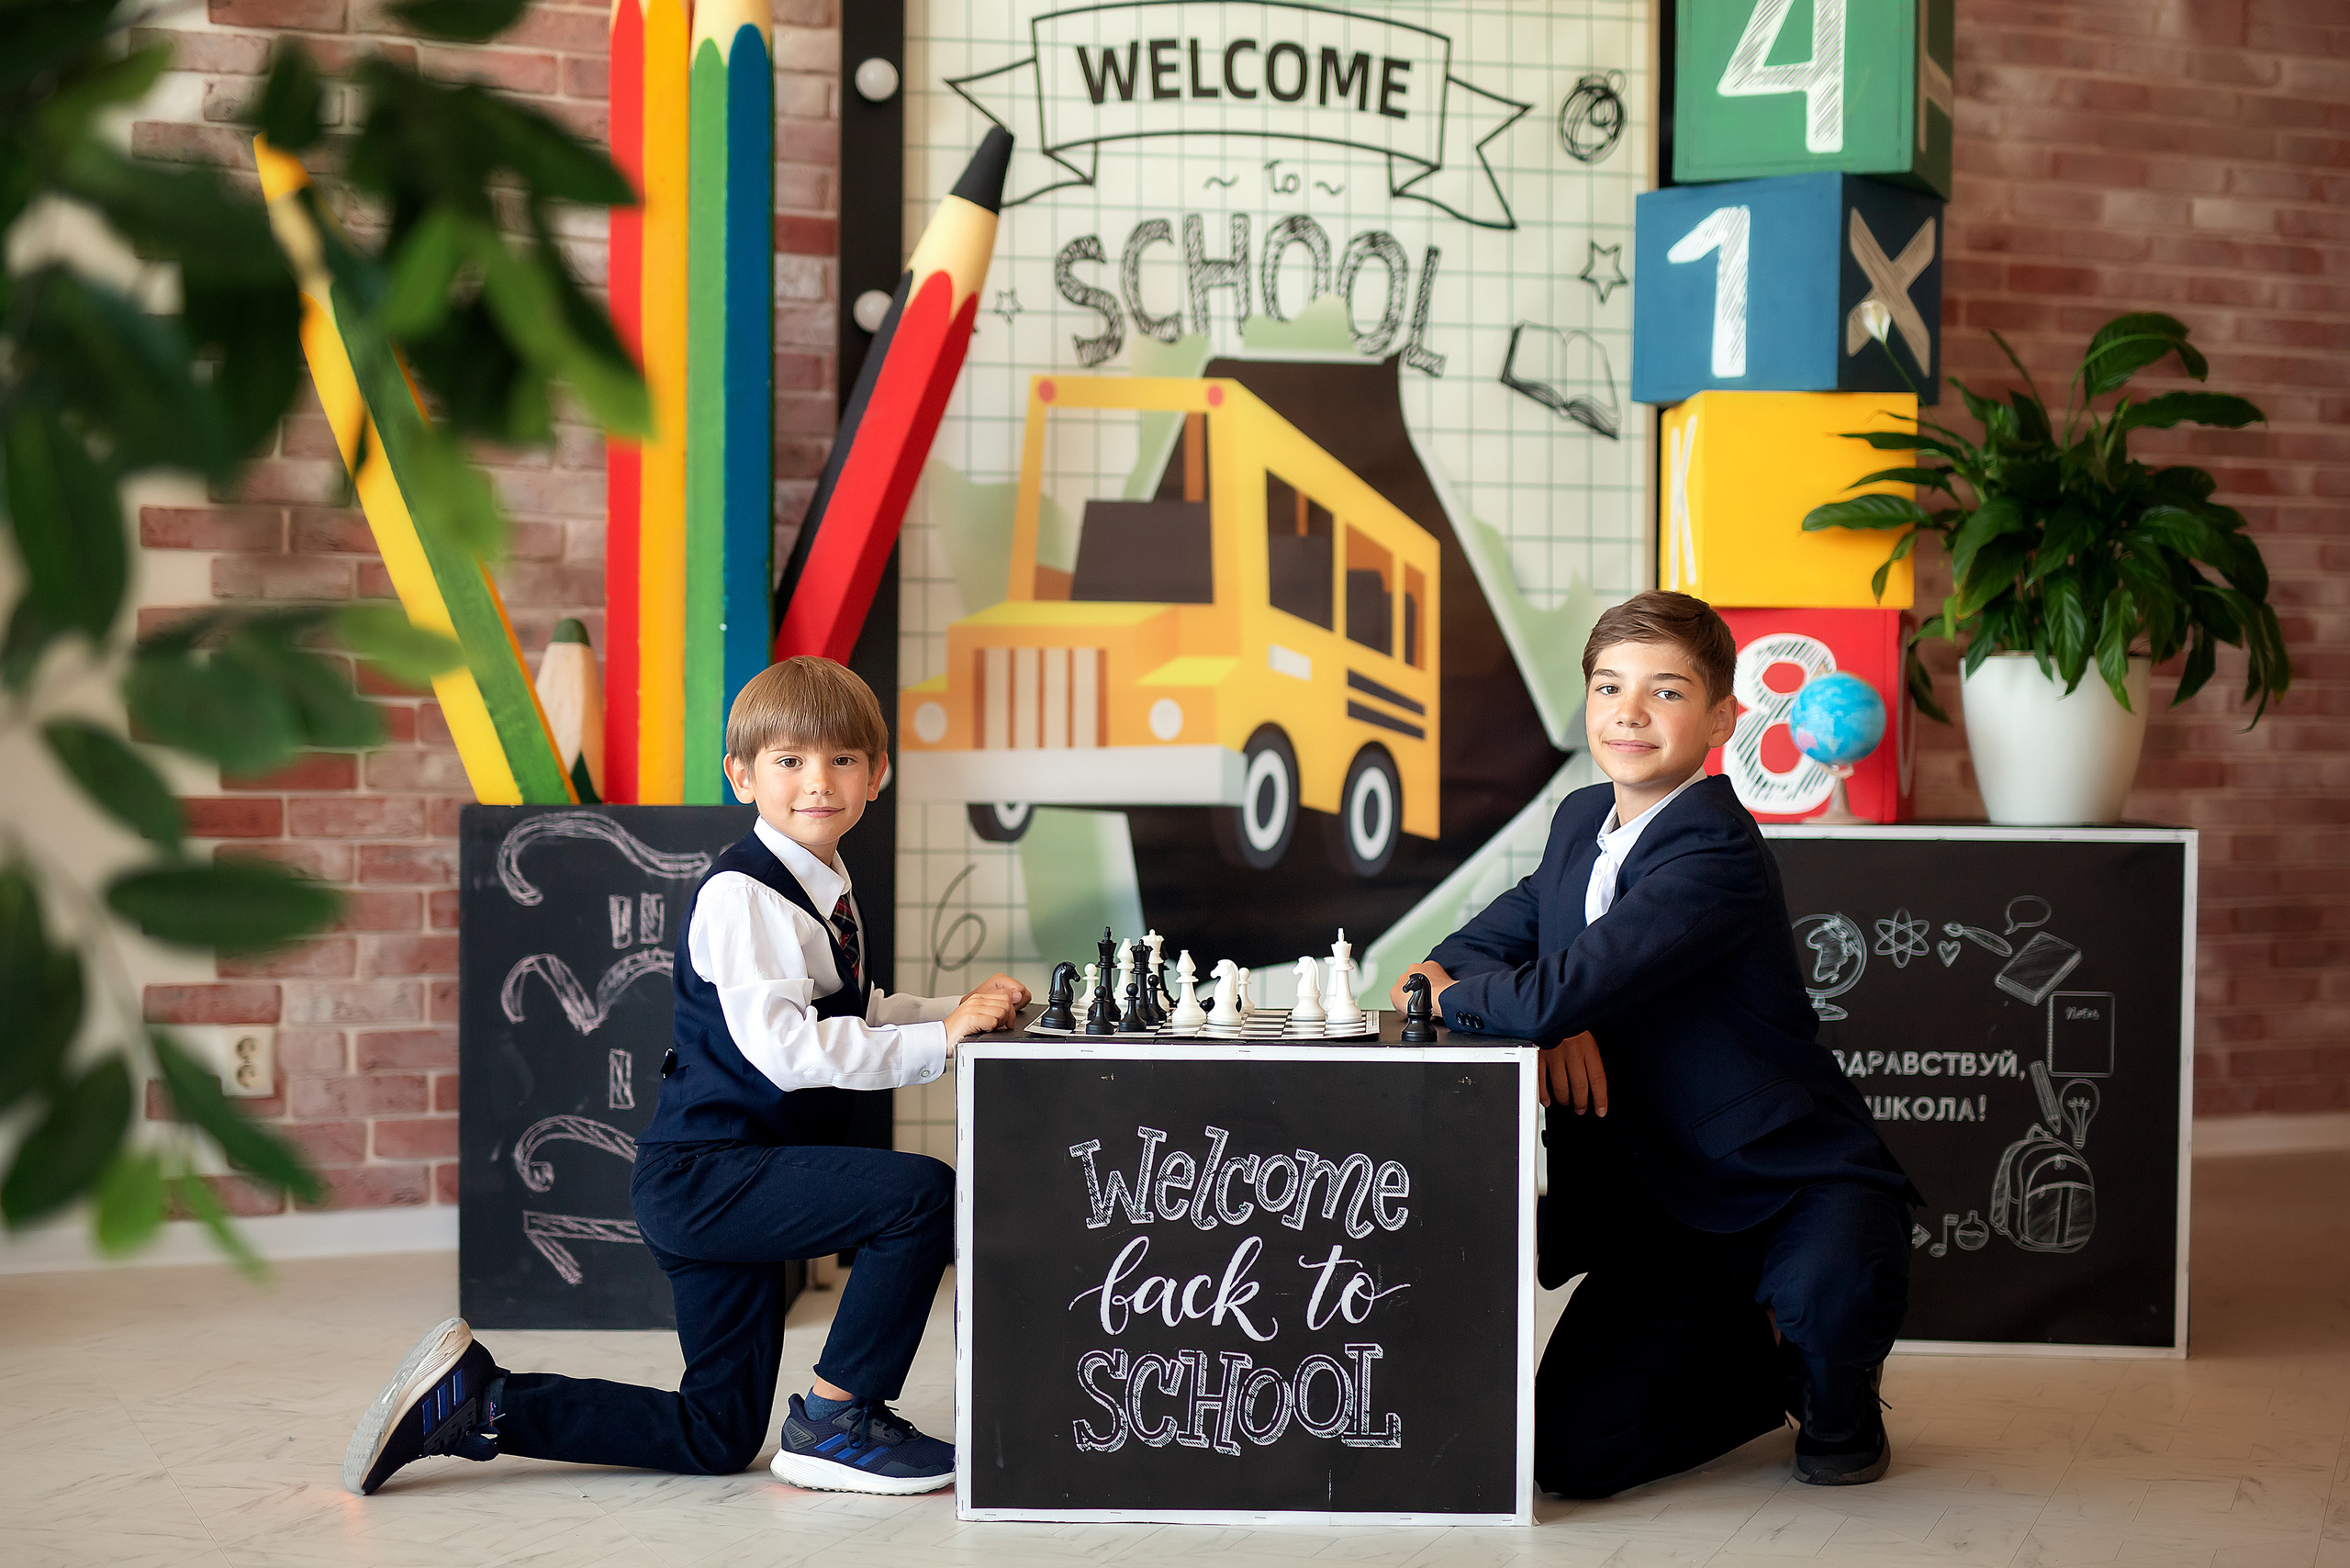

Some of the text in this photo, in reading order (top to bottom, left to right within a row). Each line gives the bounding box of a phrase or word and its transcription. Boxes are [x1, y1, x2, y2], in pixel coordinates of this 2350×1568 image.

[1076, 38, 1412, 120] WELCOME
[1717, 0, 1847, 154] 4
[1054, 213, 1447, 378] SCHOOL
[1666, 205, 1751, 378] 1
[1722, 633, 1838, 815] 8
[1863, 1093, 1987, 1122] ШКОЛА!
[1069, 1126, 1411, 1238] Welcome
[1069, 1236, 1411, 1342] back to
[1072, 1343, 1403, 1457] SCHOOL
